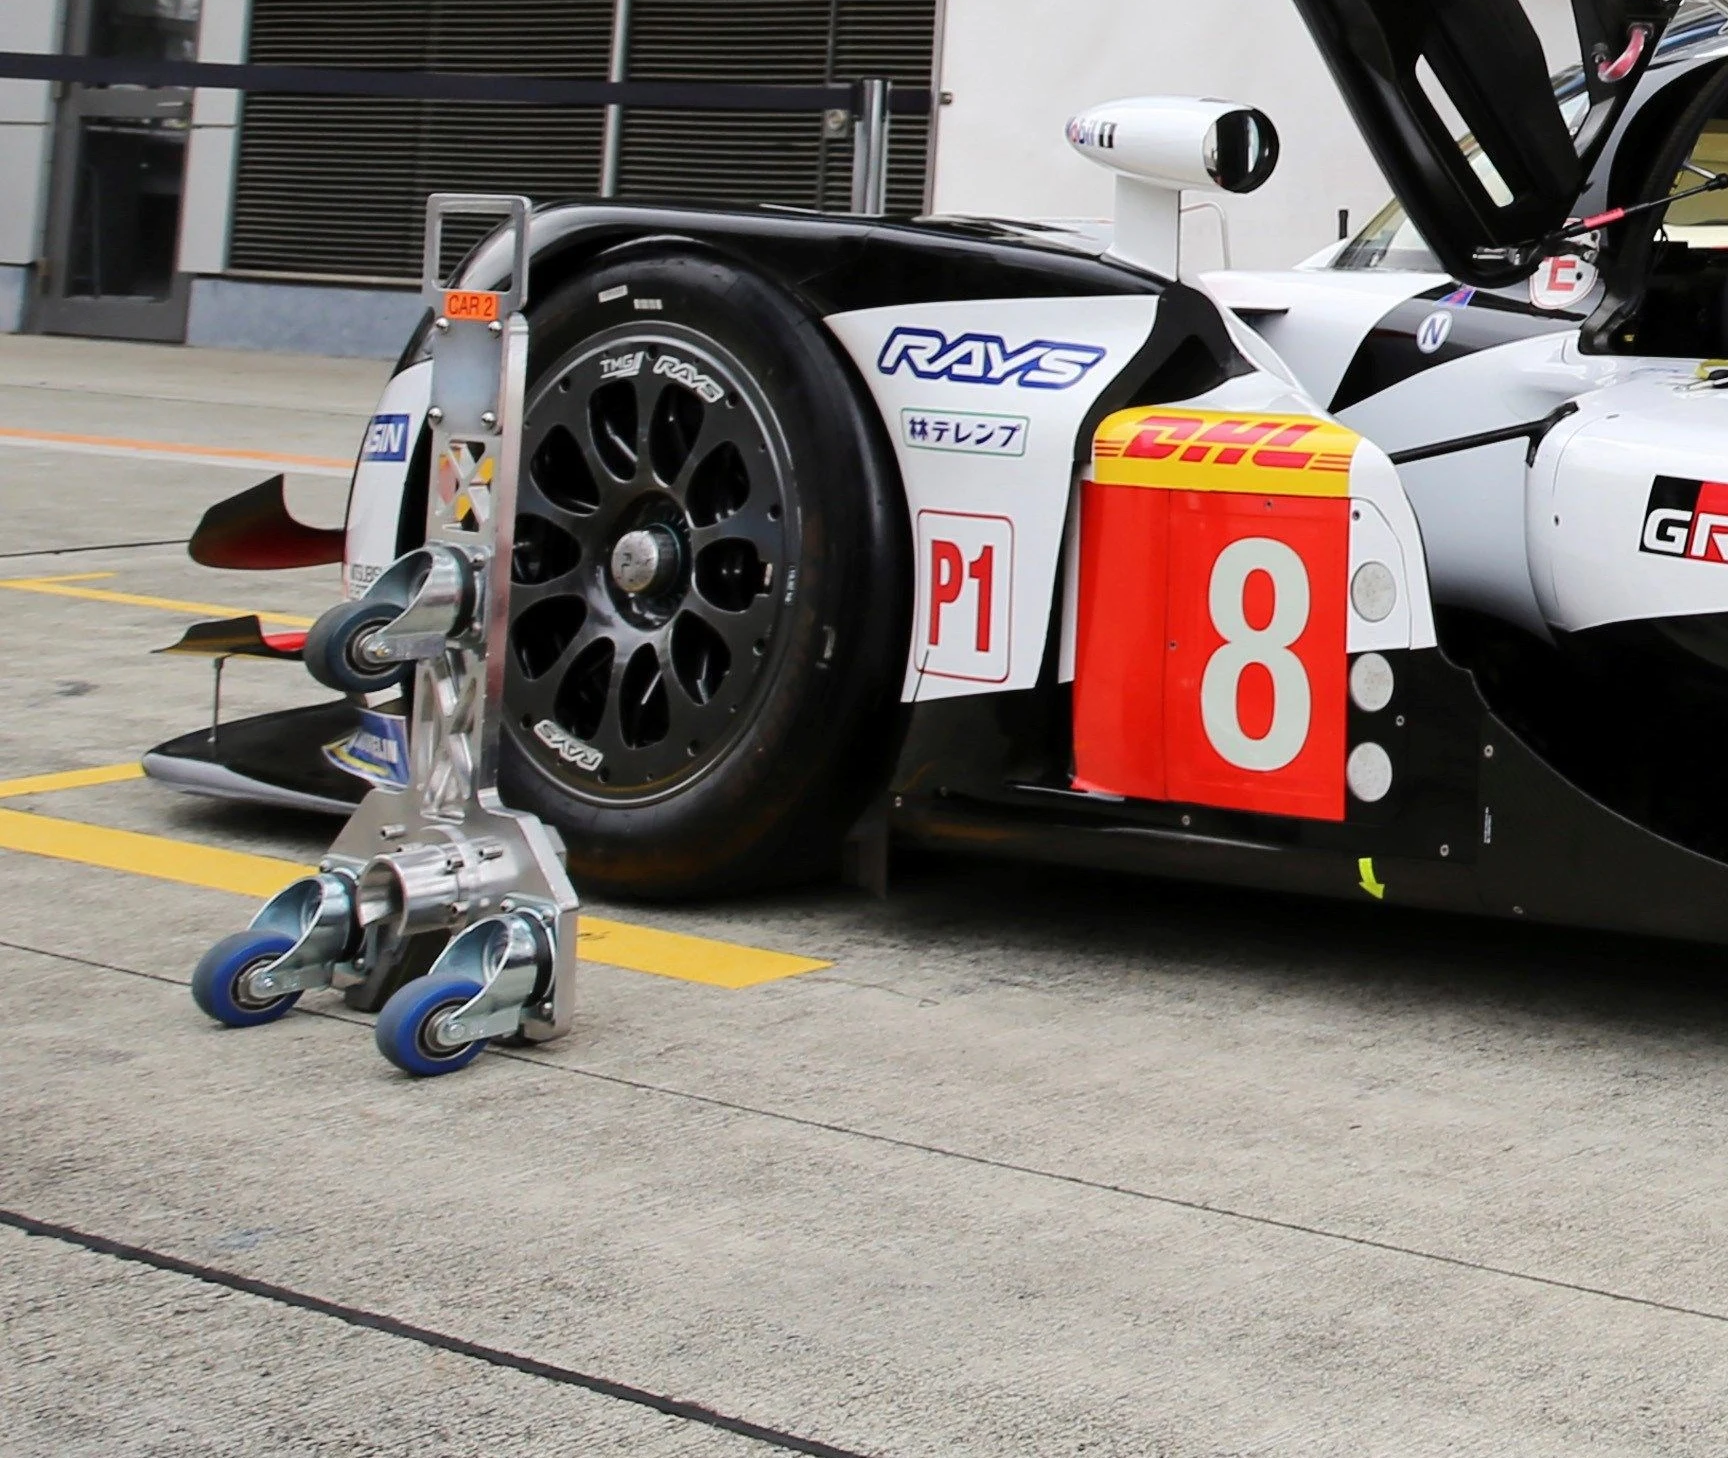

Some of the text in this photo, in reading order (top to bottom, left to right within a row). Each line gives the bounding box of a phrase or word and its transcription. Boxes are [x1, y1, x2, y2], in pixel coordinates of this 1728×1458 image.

[1546, 256, 1578, 292] E
[449, 294, 494, 317] CAR 2
[1421, 317, 1448, 345] N
[653, 355, 725, 404] RAYS
[877, 326, 1108, 390] RAYS
[908, 417, 1022, 448] 林テレンプ
[1122, 415, 1320, 469] DHL
[927, 539, 993, 654] P1
[1200, 535, 1312, 772] 8
[533, 719, 604, 773] RAYS
